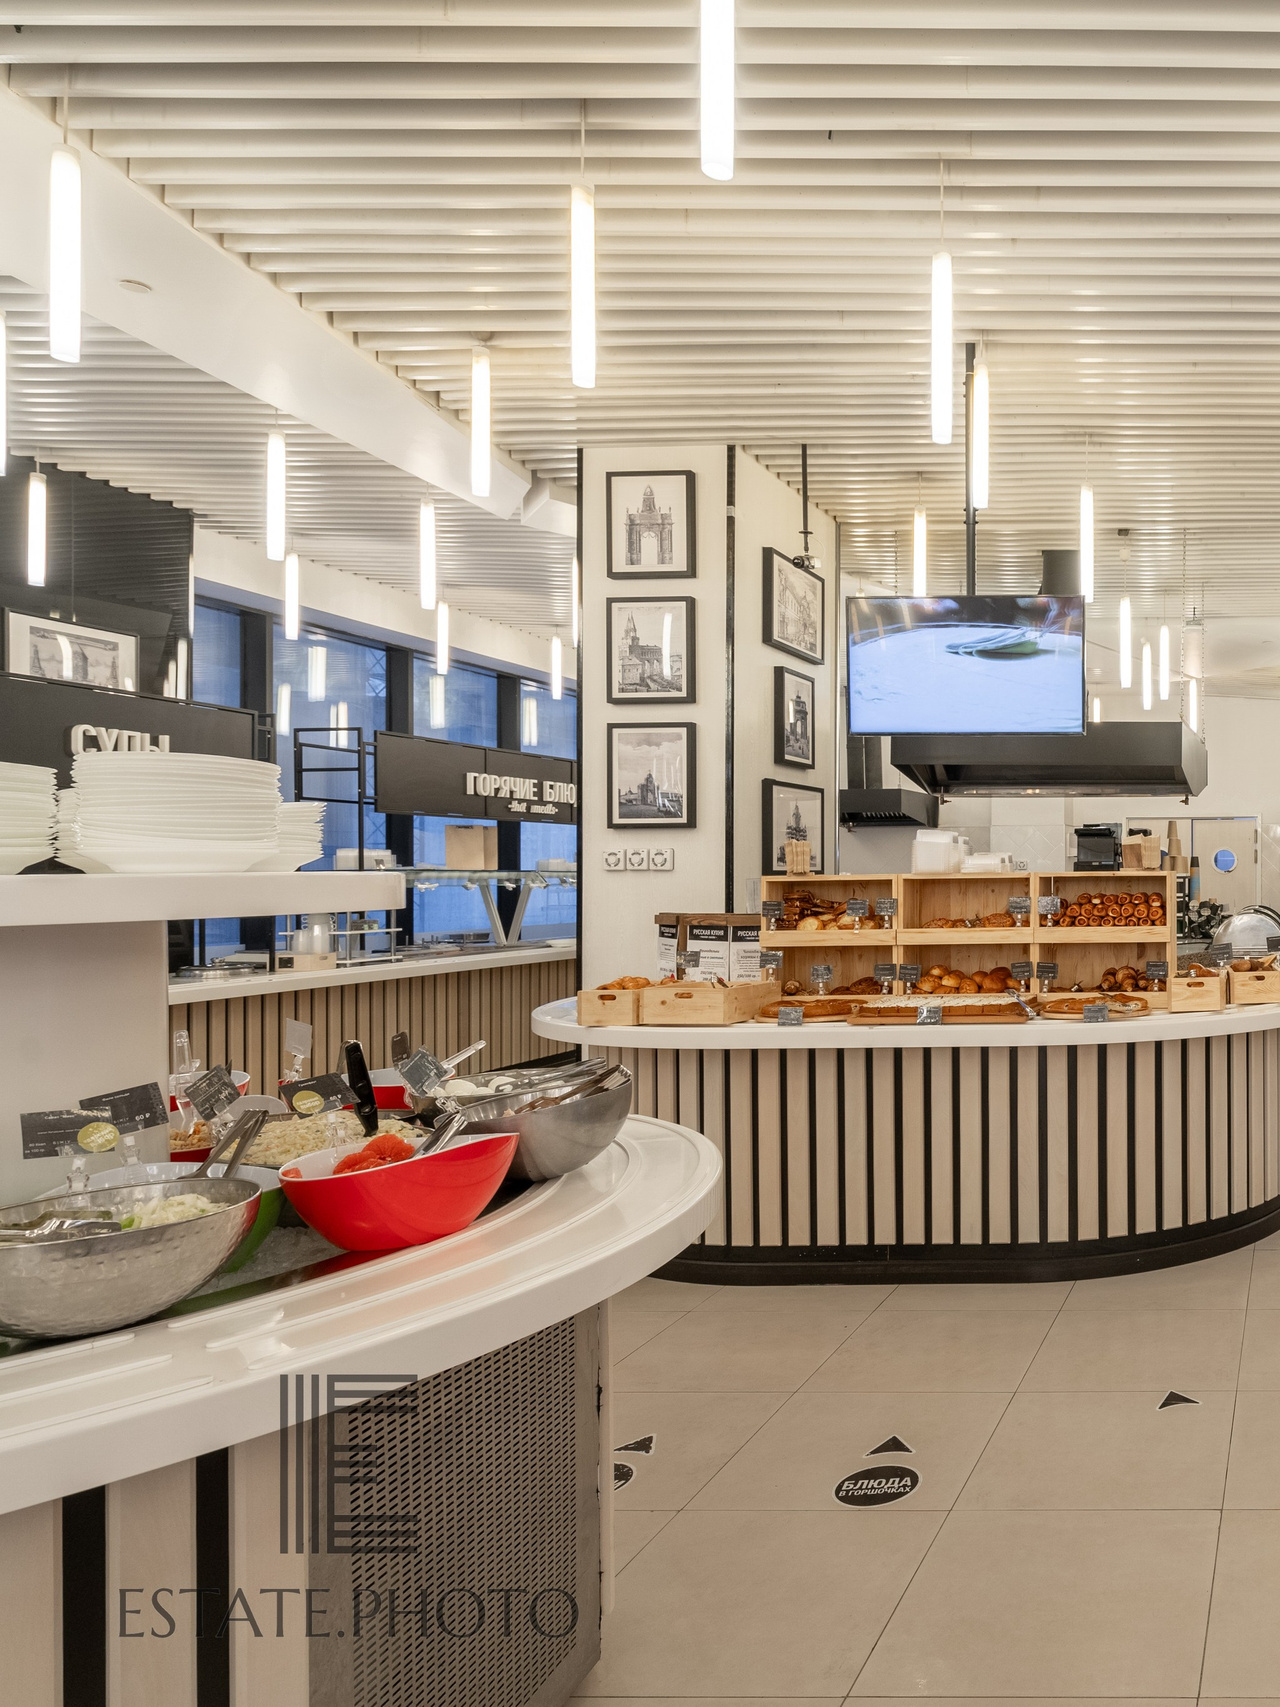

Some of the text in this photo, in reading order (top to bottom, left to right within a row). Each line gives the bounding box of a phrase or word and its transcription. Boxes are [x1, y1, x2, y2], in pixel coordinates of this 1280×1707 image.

[70, 724, 170, 753] СУПЫ
[466, 772, 578, 808] ГОРЯЧИЕ БЛЮ
[841, 1477, 912, 1491] БЛЮДА
[848, 1486, 912, 1496] ГОРШОЧКАХ
